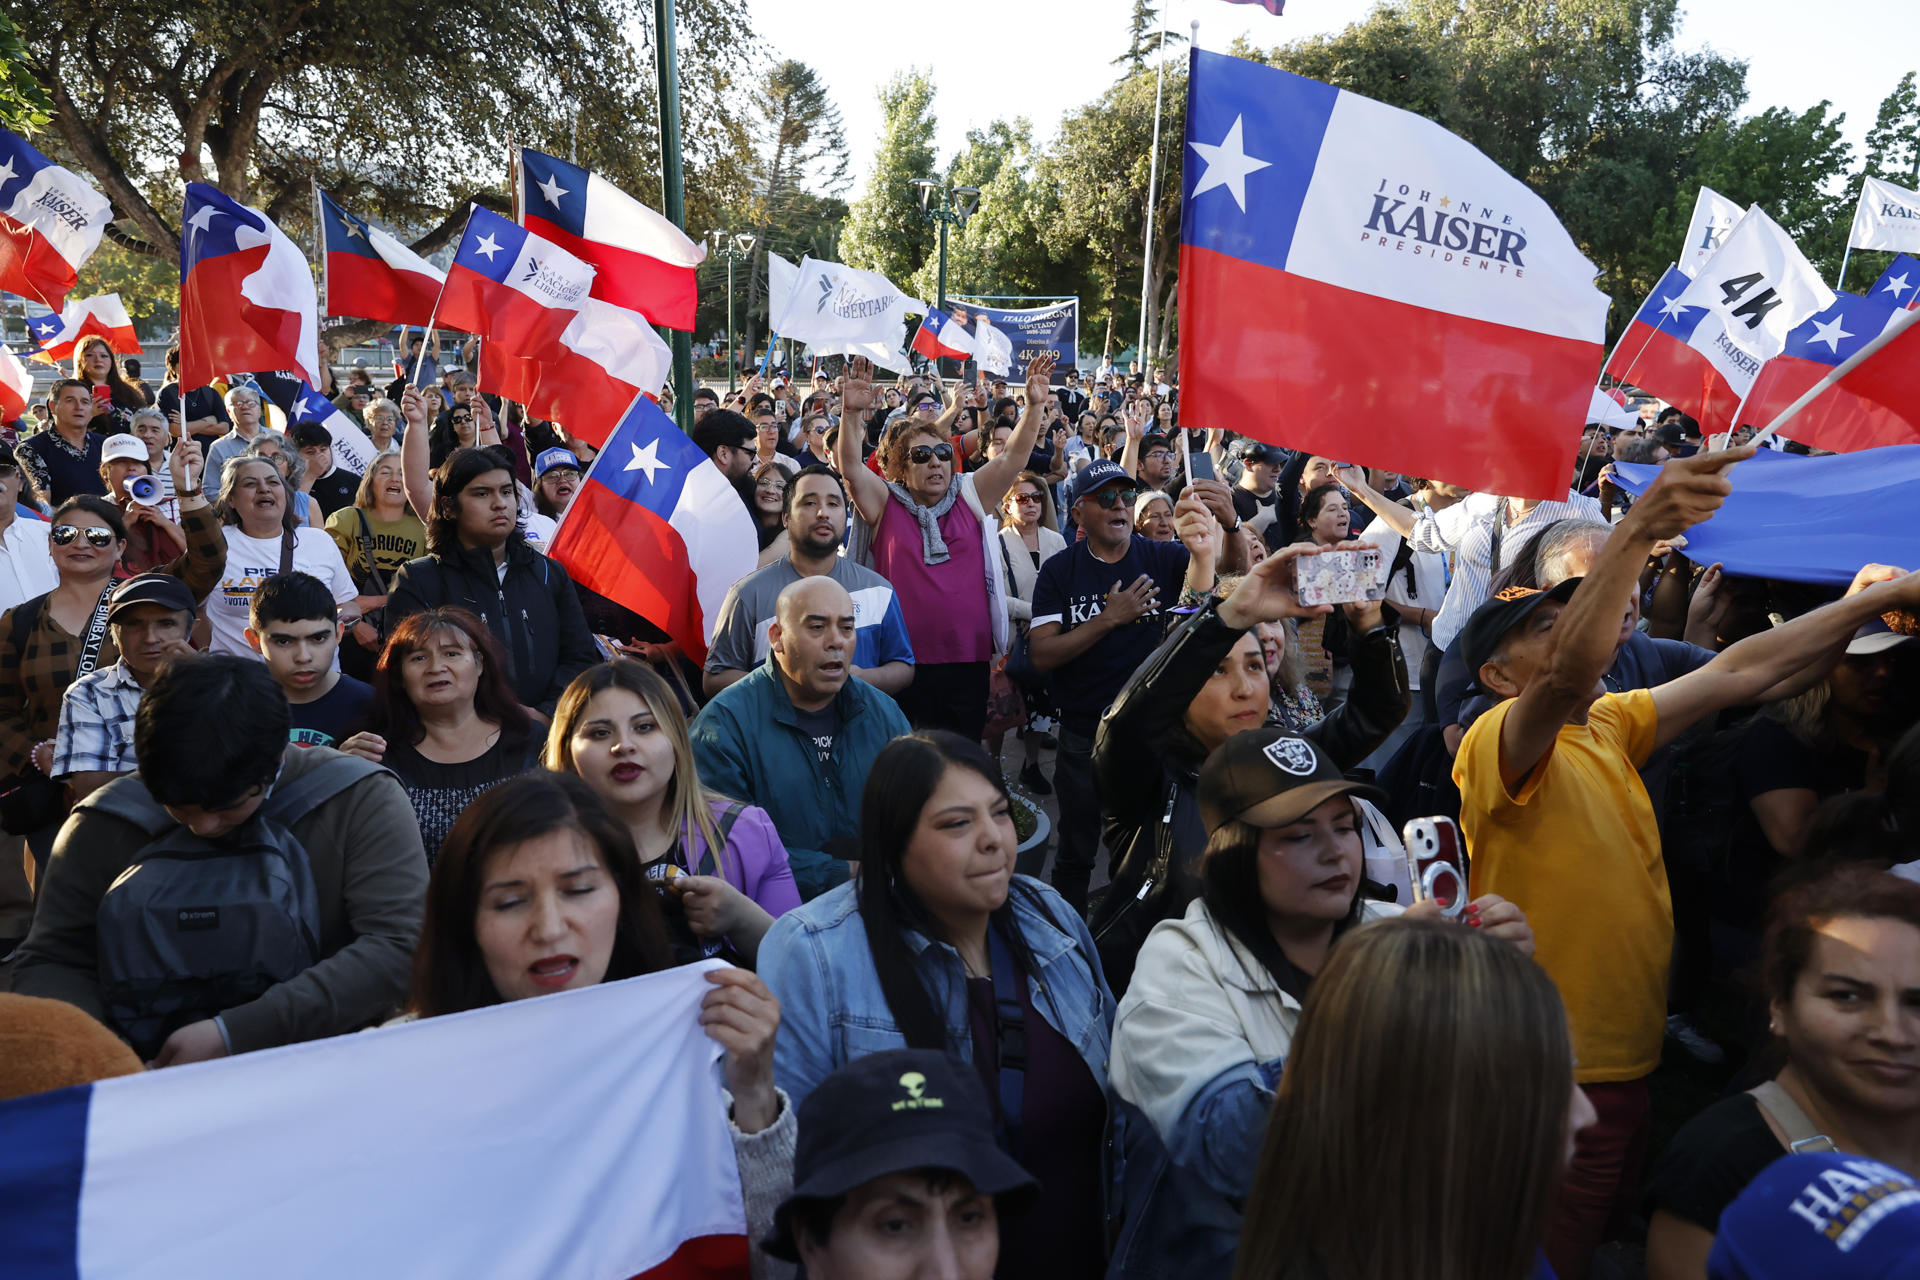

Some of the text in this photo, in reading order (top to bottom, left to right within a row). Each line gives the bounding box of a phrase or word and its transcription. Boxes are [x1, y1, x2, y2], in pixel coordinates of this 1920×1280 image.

[36, 191, 88, 232] KAISER
[1364, 193, 1528, 267] KAISER
[1361, 232, 1524, 278] PRESIDENTE
[1719, 272, 1783, 330] 4K
[1018, 321, 1057, 329] DIPUTADO
[1716, 332, 1760, 377] KAISER
